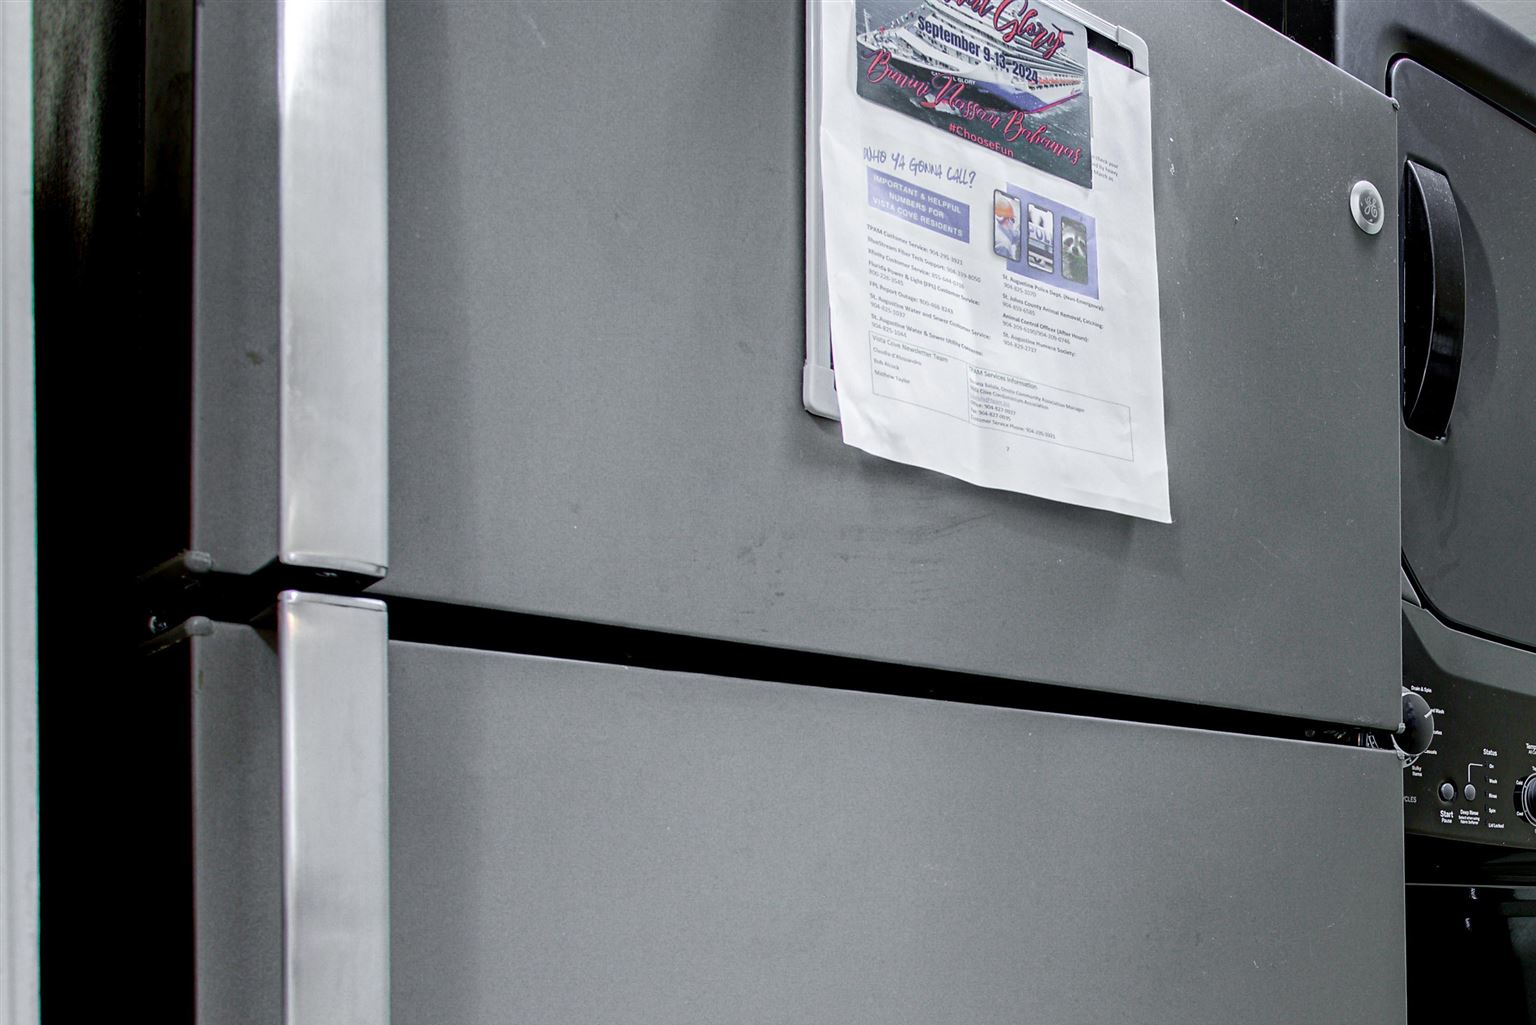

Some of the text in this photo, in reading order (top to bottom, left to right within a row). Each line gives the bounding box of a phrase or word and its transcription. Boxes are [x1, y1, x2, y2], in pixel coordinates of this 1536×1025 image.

[918, 15, 981, 57] September
[1012, 62, 1039, 84] 2024
[993, 0, 1065, 60] Glory
[932, 74, 1001, 129] Nassau
[1003, 109, 1081, 165] Bahamas
[949, 122, 1014, 158] #ChooseFun
[864, 146, 977, 189] WHO YA GONNA CALL?
[873, 175, 961, 214] IMPORTANT & HELPFUL
[889, 191, 945, 219] NUMBERS FOR
[872, 196, 963, 237] VISTA COVE RESIDENTS
[1483, 748, 1497, 757] Status
[1440, 810, 1454, 819] Start
